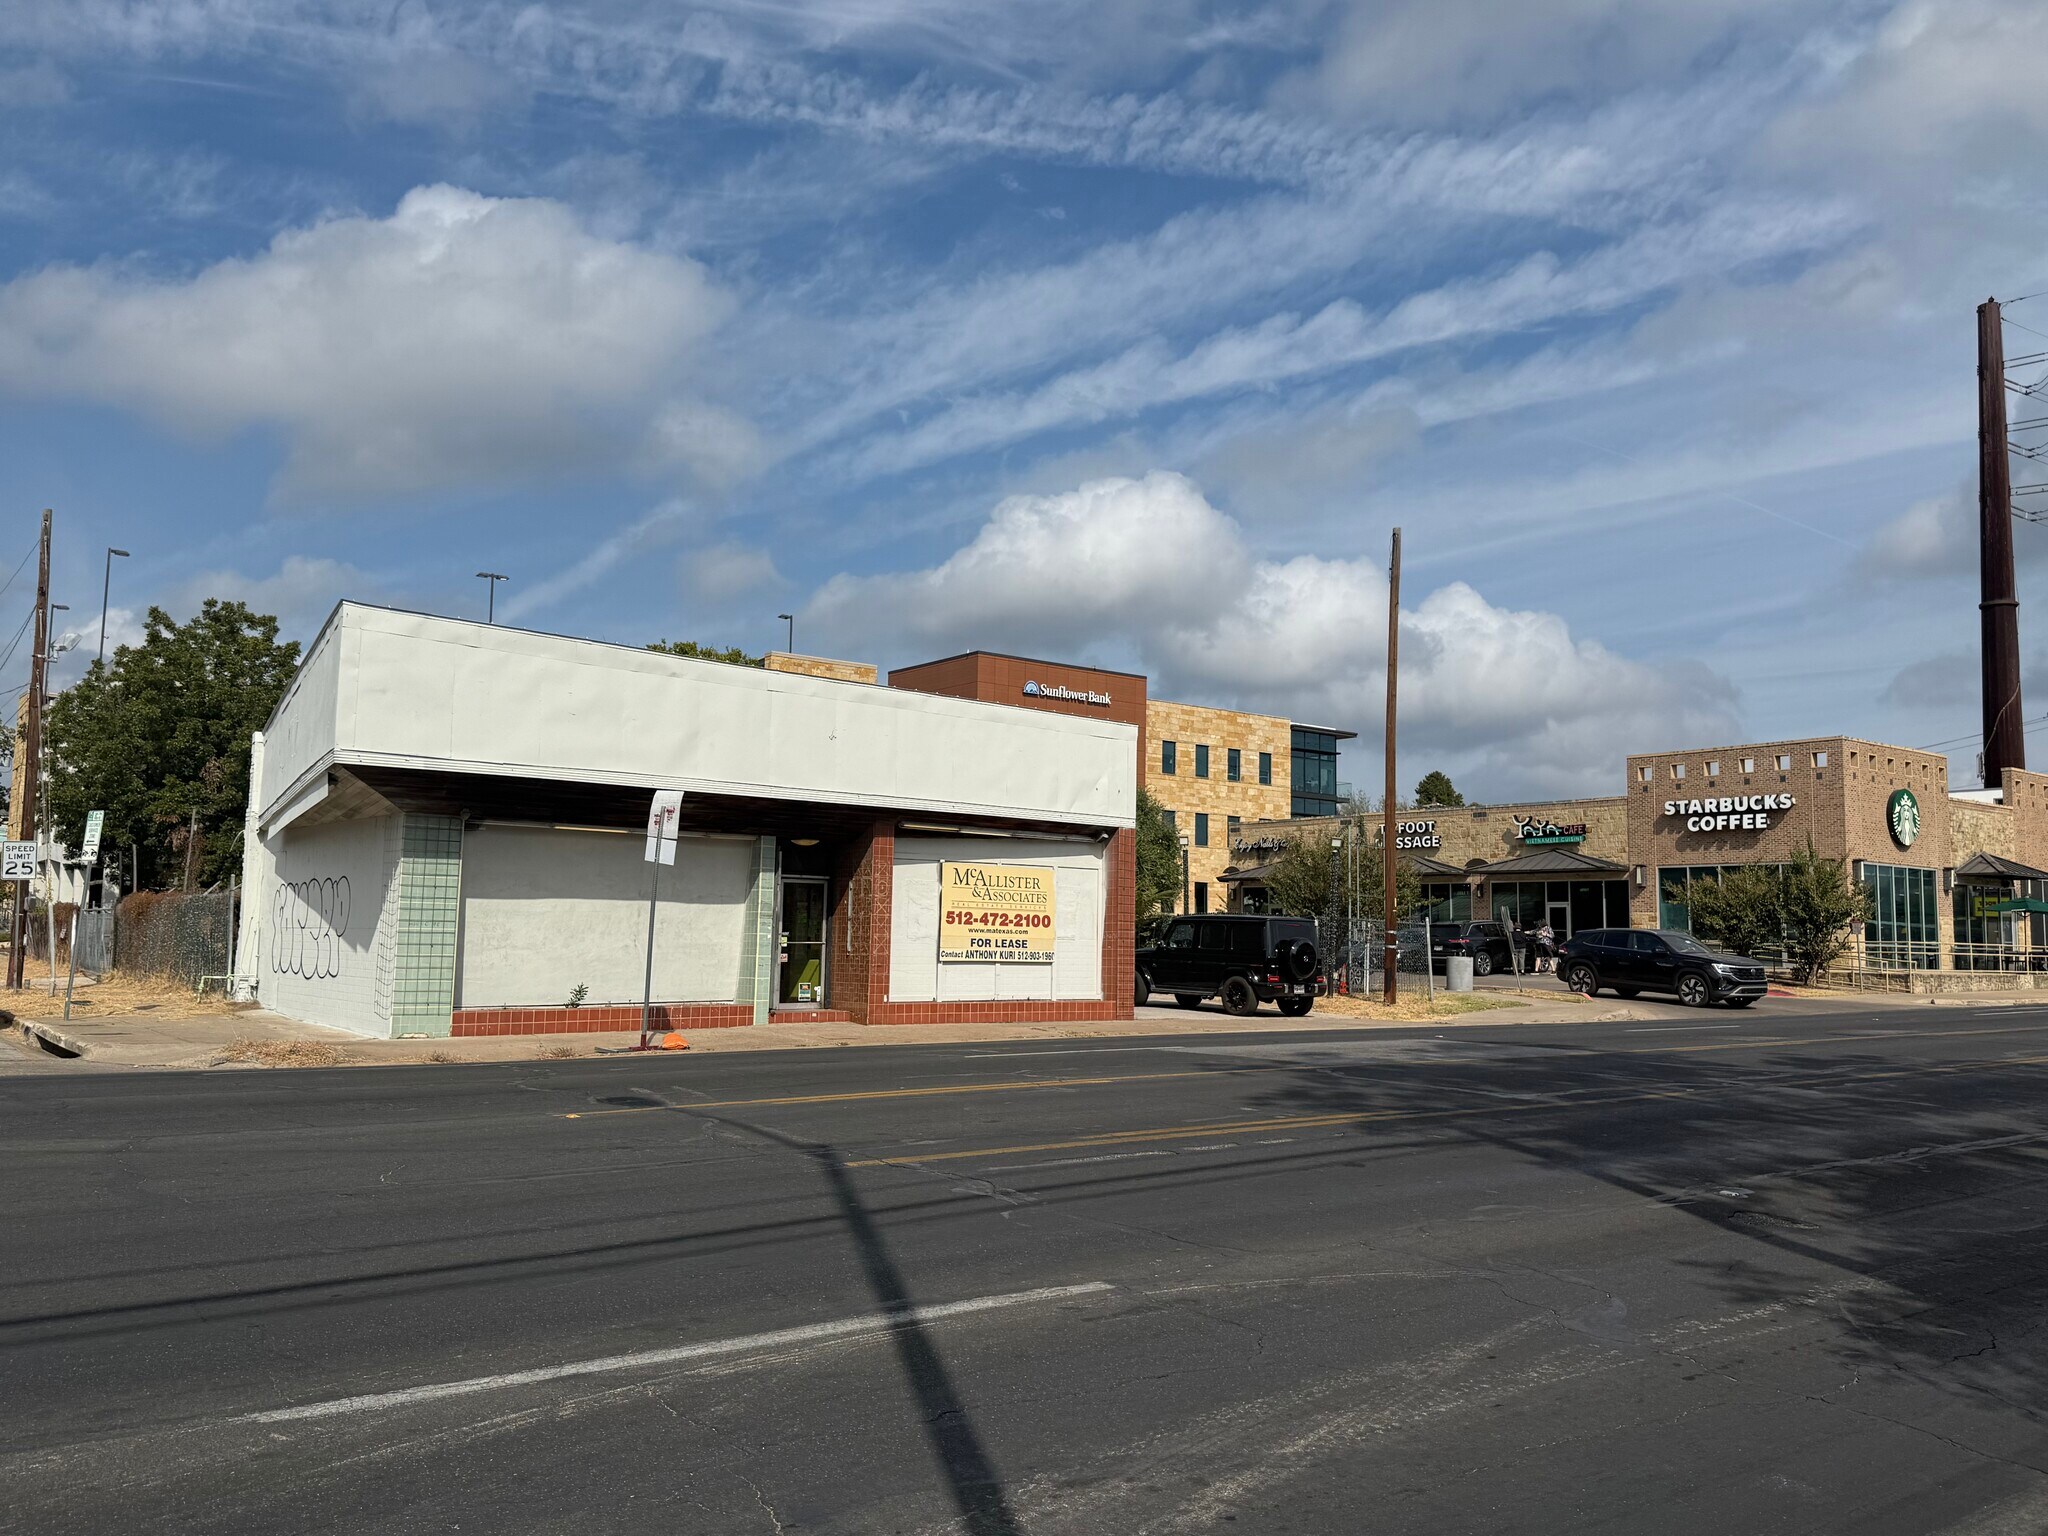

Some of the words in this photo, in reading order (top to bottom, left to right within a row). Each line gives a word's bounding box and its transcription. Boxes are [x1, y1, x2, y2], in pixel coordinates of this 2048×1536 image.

[1040, 684, 1088, 701] Sunflower
[1088, 691, 1111, 704] Bank
[1664, 794, 1792, 815] STARBUCKS
[1398, 821, 1435, 834] FOOT
[1687, 813, 1767, 832] COFFEE
[1563, 826, 1584, 834] CAFE
[5, 861, 33, 875] 25
[945, 911, 1051, 928] 512-472-2100
[970, 938, 992, 948] FOR
[995, 939, 1028, 949] LEASE
[941, 950, 964, 958] Contact
[965, 950, 998, 960] ANTHONY
[999, 950, 1016, 960] KURI
